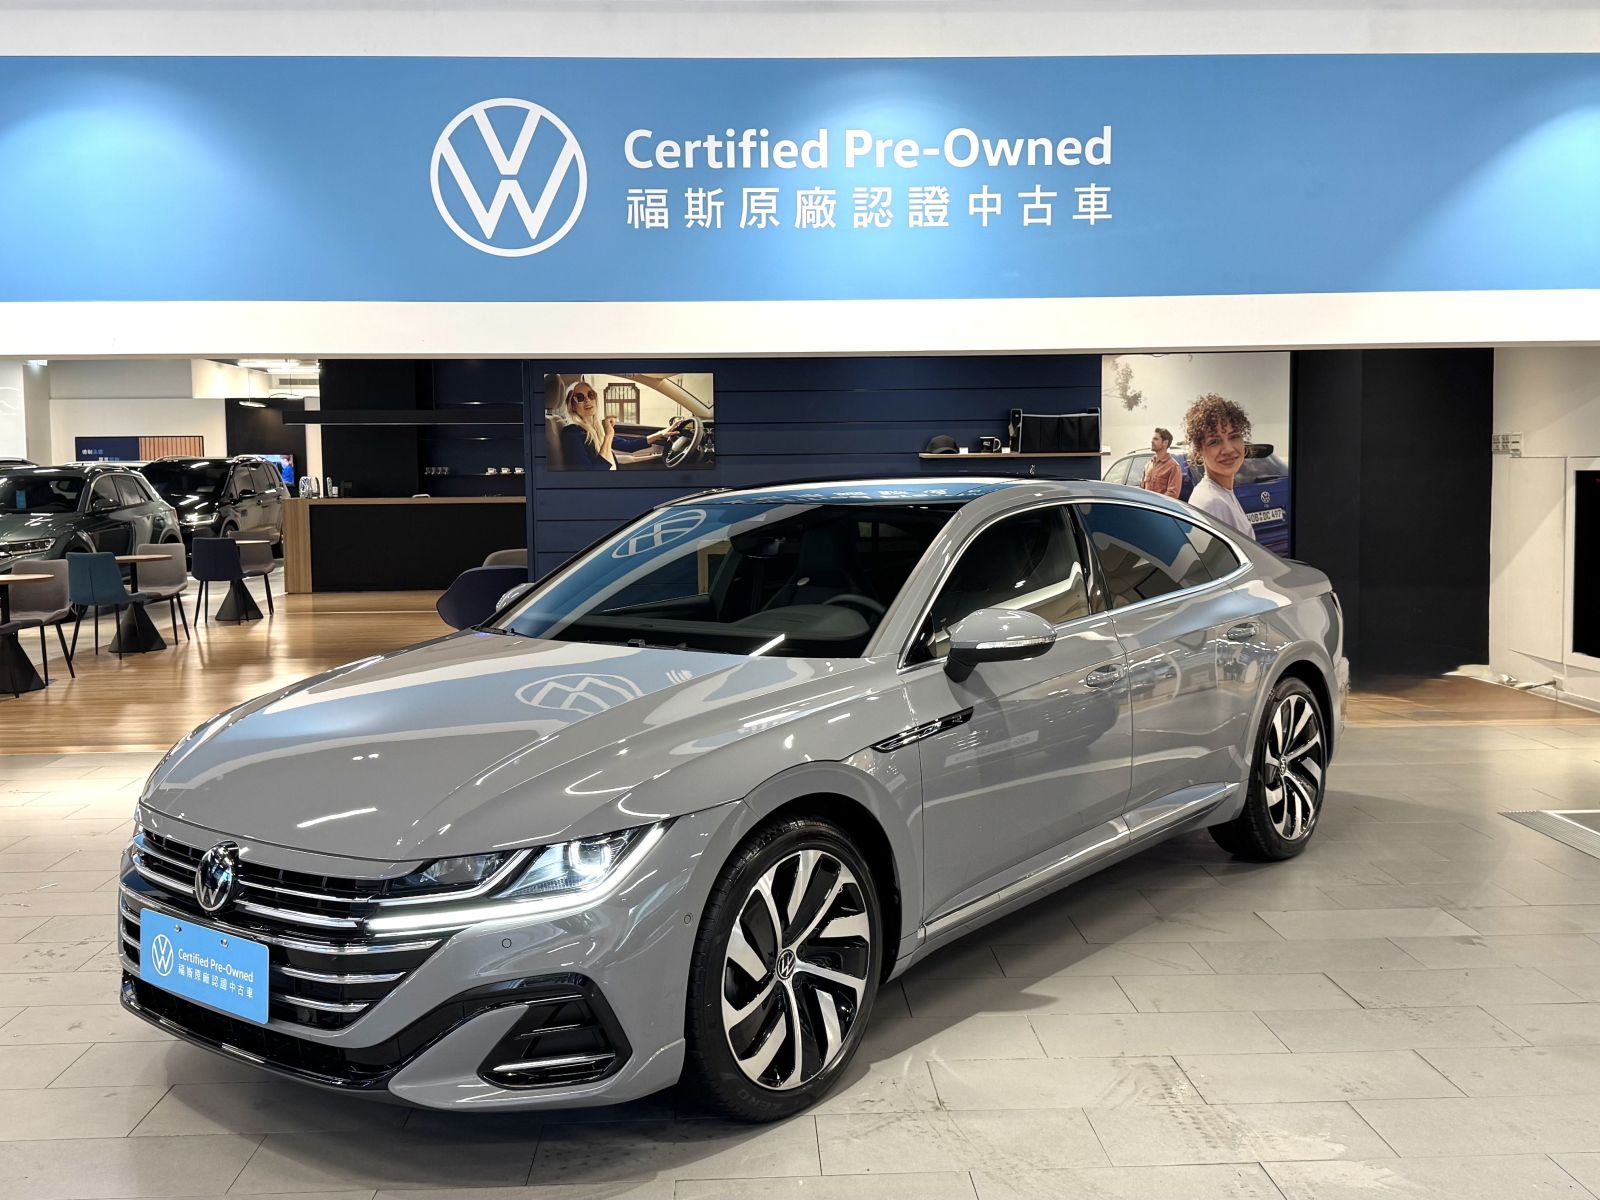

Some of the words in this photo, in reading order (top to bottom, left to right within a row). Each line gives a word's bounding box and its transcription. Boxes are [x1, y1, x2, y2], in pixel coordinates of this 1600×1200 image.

[624, 128, 828, 169] Certified
[845, 125, 1112, 169] Pre-Owned
[626, 182, 1113, 229] 福斯原廠認證中古車
[178, 948, 209, 968] Certified
[210, 958, 254, 983] Pre-Owned
